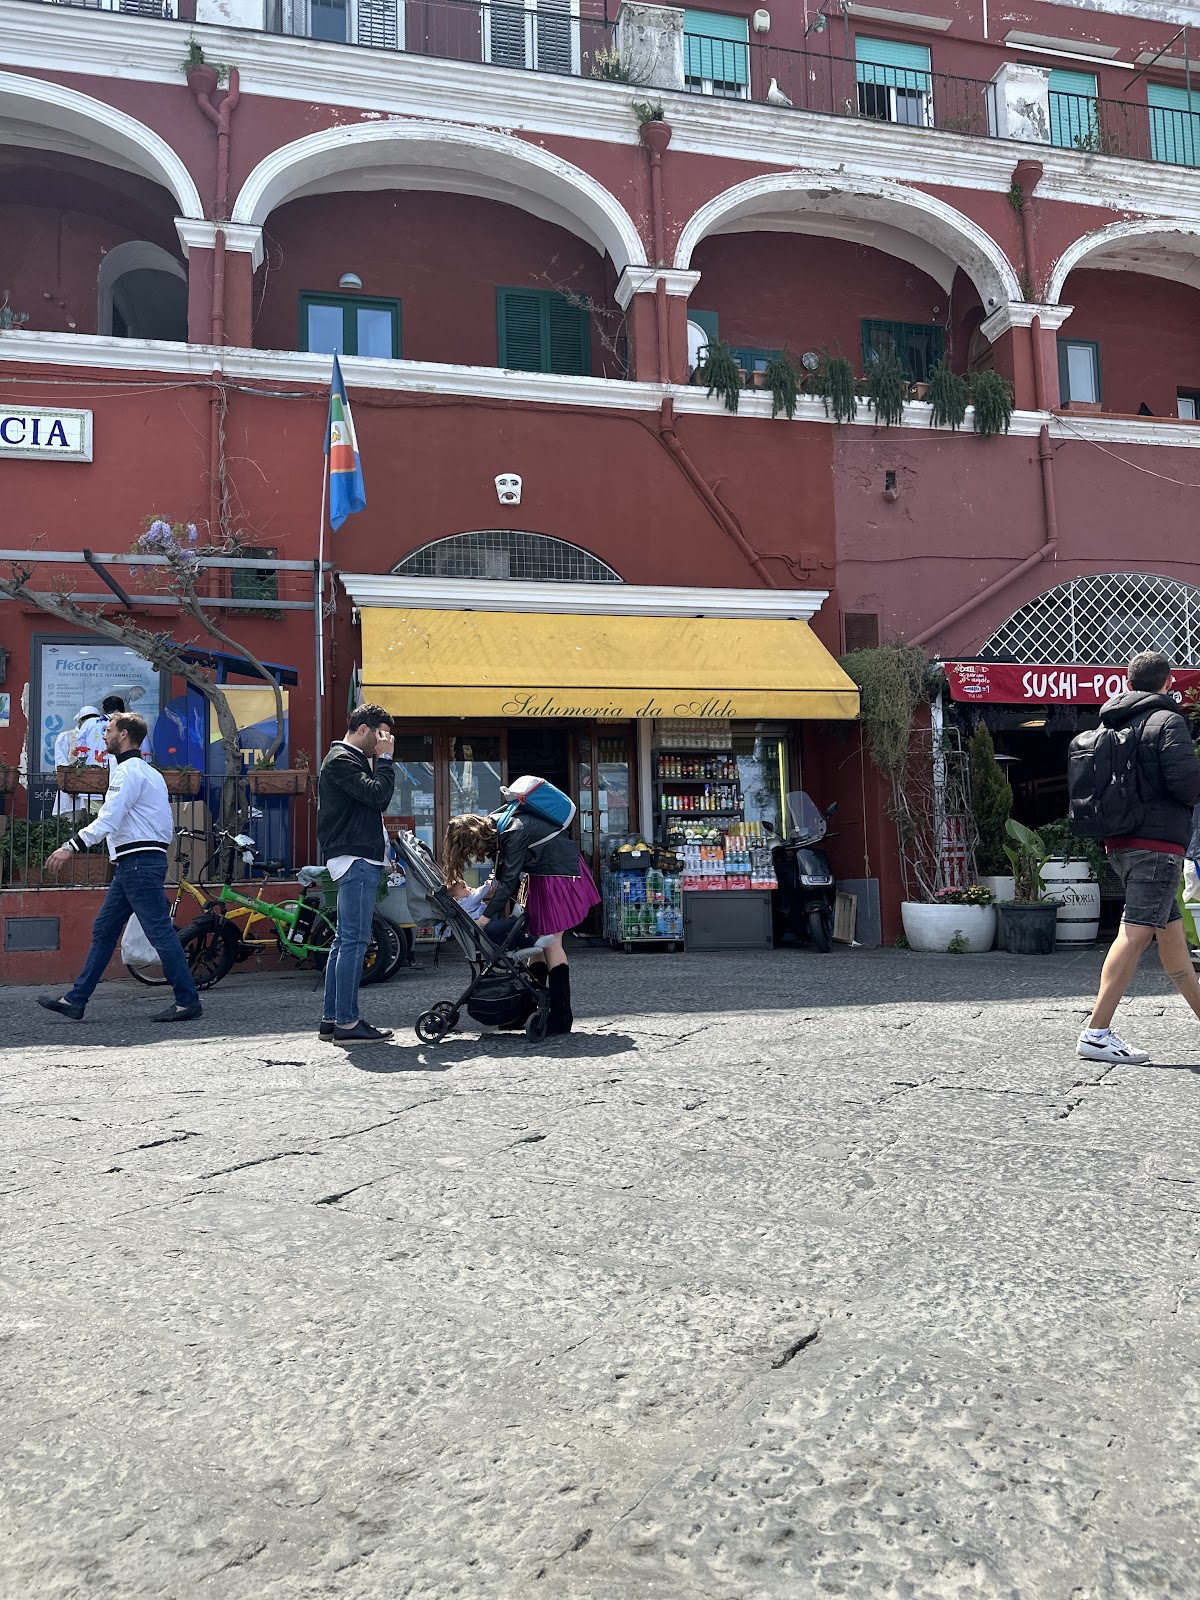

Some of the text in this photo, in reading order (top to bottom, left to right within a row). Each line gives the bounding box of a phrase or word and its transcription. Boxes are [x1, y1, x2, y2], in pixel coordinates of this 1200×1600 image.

[0, 416, 71, 447] CIA
[1022, 670, 1131, 700] SUSHI-POK
[501, 692, 739, 717] Salumeria da Aldo
[239, 748, 275, 765] TM
[1061, 894, 1095, 903] ASTORIA
